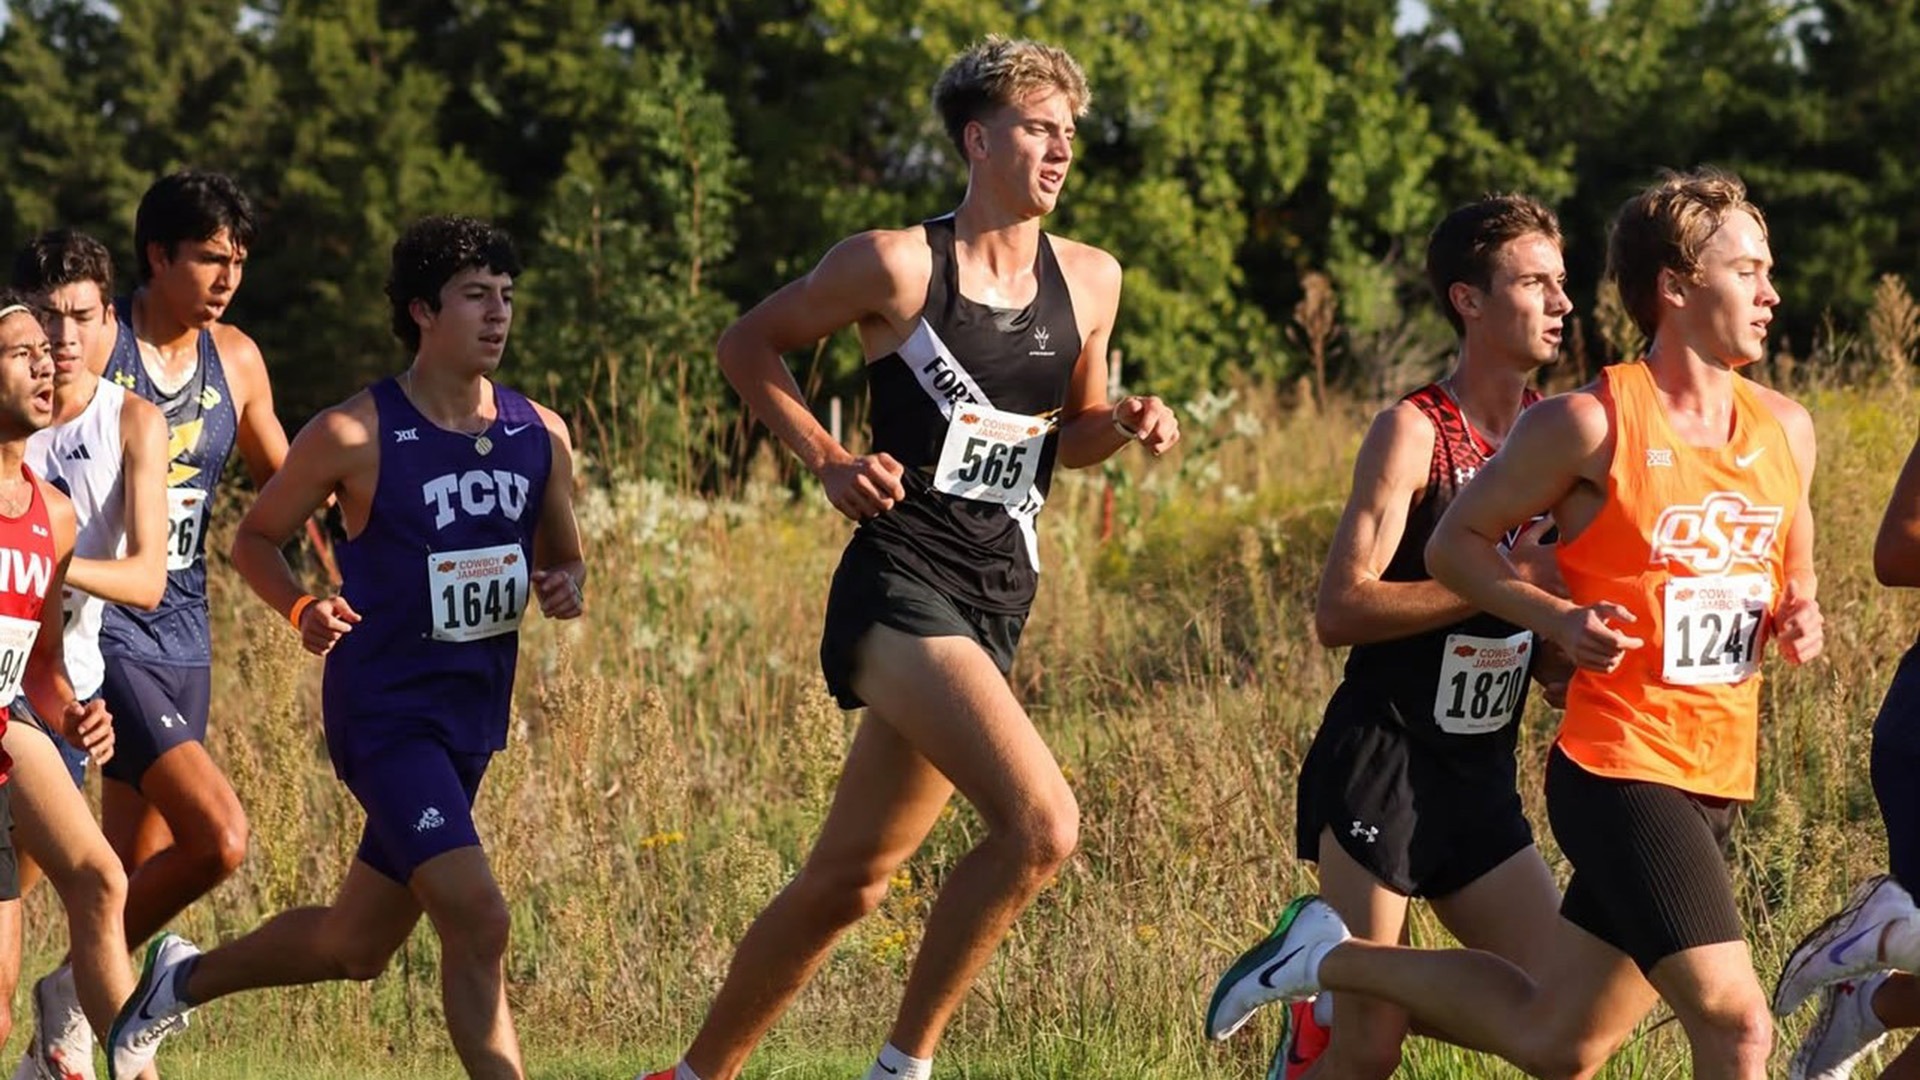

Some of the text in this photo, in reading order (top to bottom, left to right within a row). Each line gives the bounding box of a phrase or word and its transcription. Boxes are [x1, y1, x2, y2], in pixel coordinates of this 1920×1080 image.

[958, 436, 1027, 490] 565
[422, 470, 530, 531] TCU
[456, 565, 504, 580] JAMBOREE
[459, 556, 501, 570] COWBOY
[442, 577, 517, 629] 1641
[1699, 588, 1741, 599] COWB
[1676, 609, 1763, 668] 1247
[1446, 667, 1522, 719] 1820
